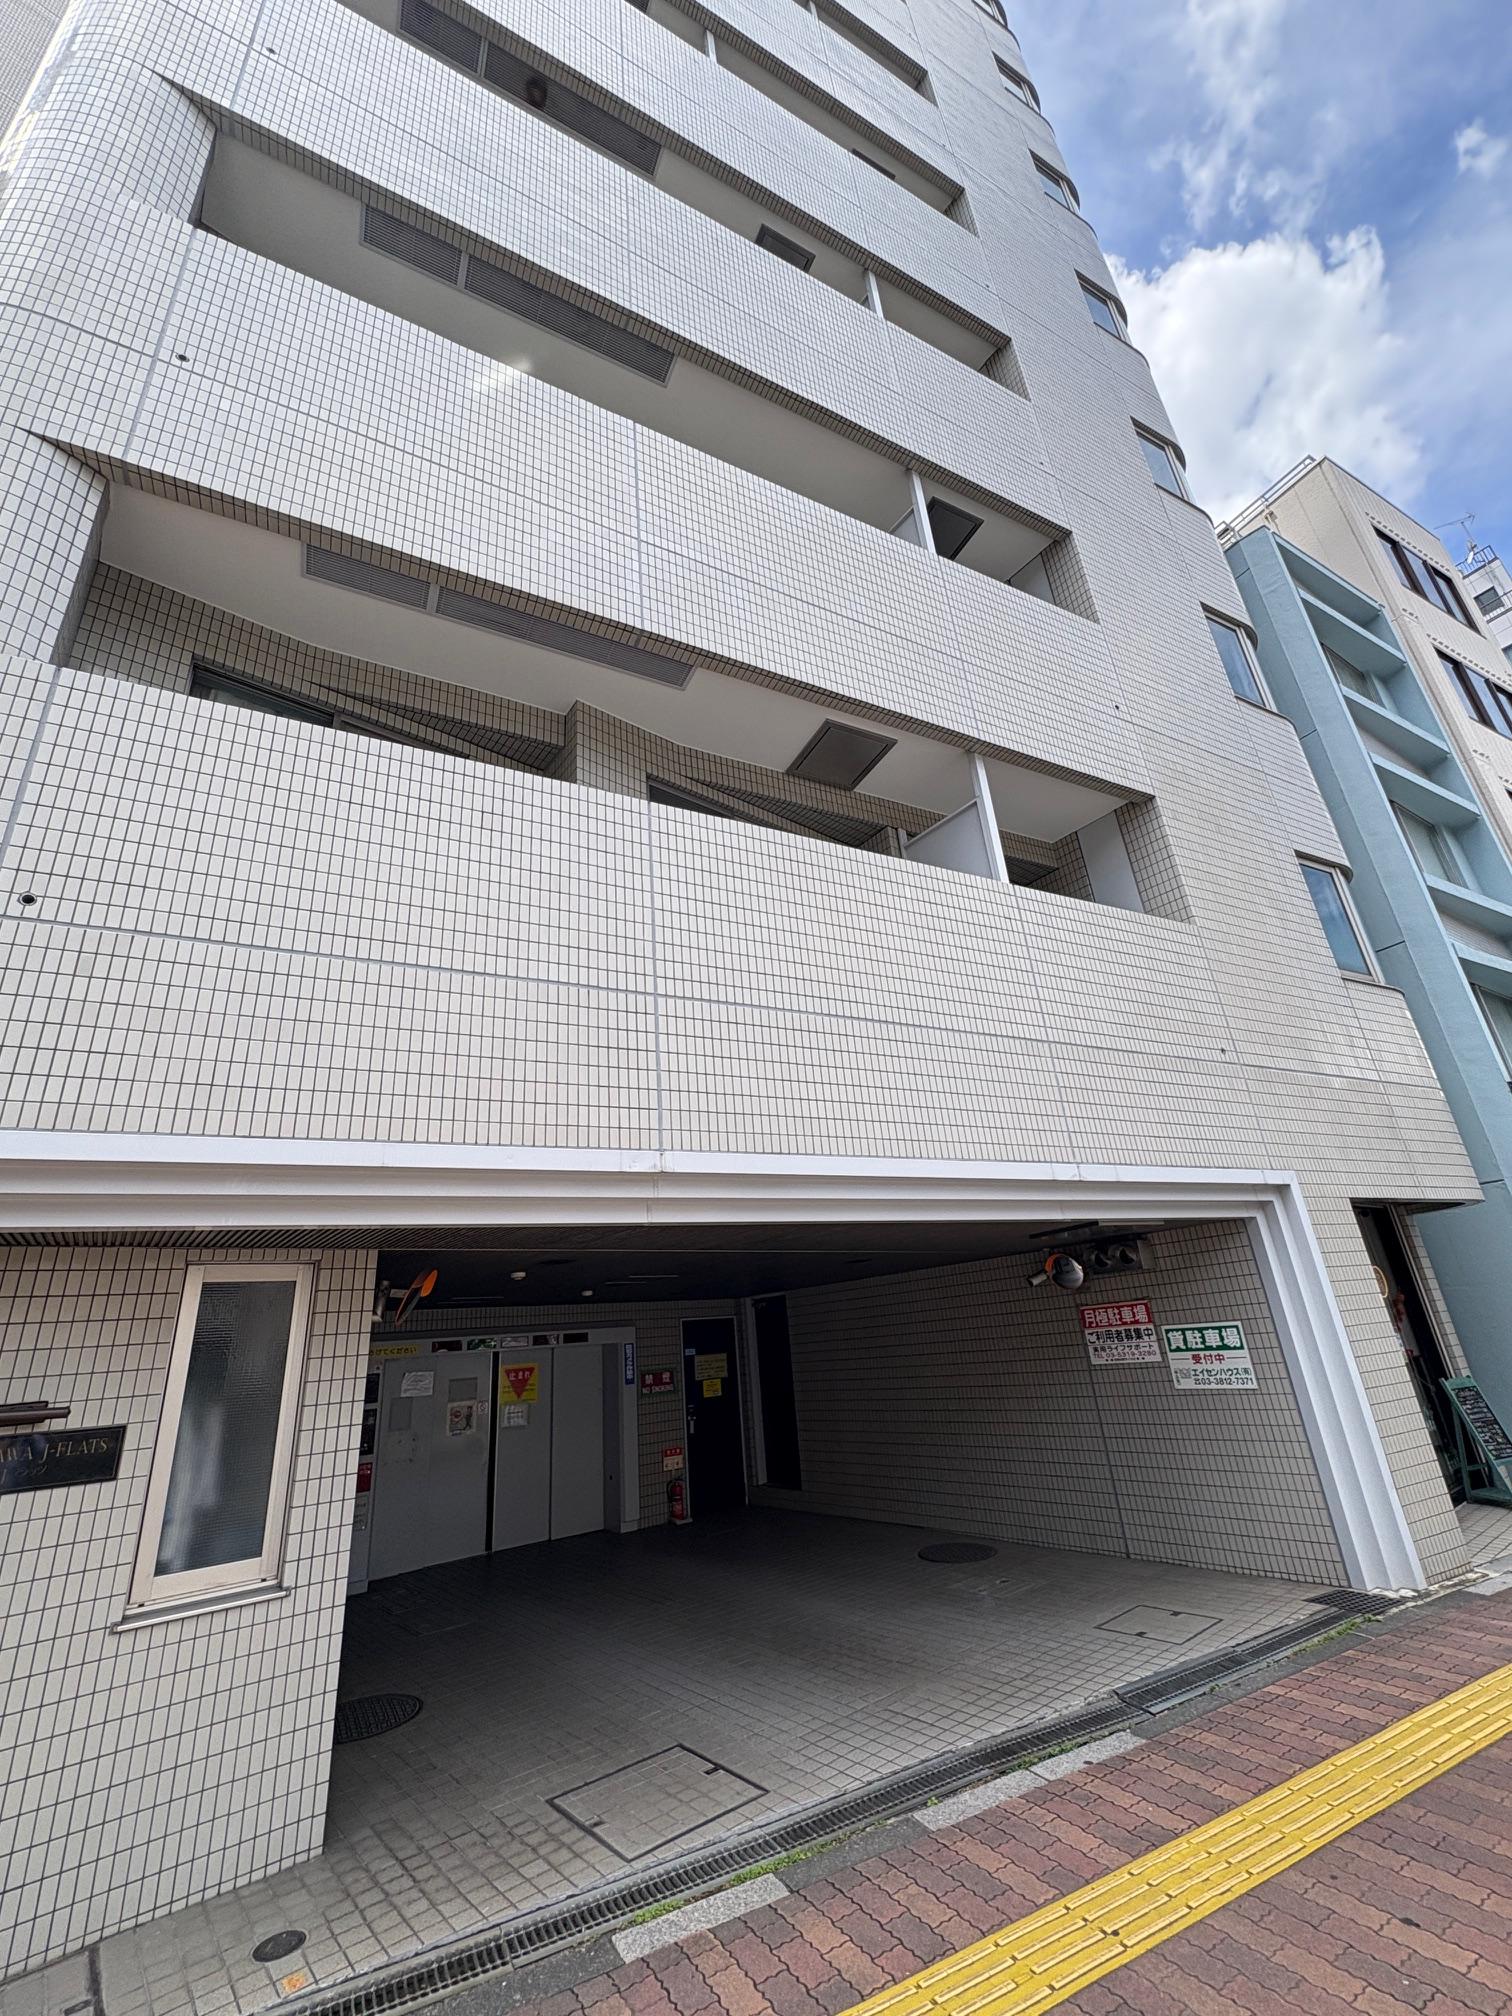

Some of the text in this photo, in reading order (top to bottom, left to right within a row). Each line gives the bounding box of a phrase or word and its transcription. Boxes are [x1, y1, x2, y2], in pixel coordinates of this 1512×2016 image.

[1084, 1304, 1149, 1327] 月極駐車場
[1087, 1327, 1154, 1344] ご利用者募集中
[1167, 1327, 1241, 1349] 貸駐車場
[1191, 1353, 1226, 1365] 受付中
[509, 1370, 530, 1380] 止まれ
[38, 1437, 109, 1464] J-FLATS
